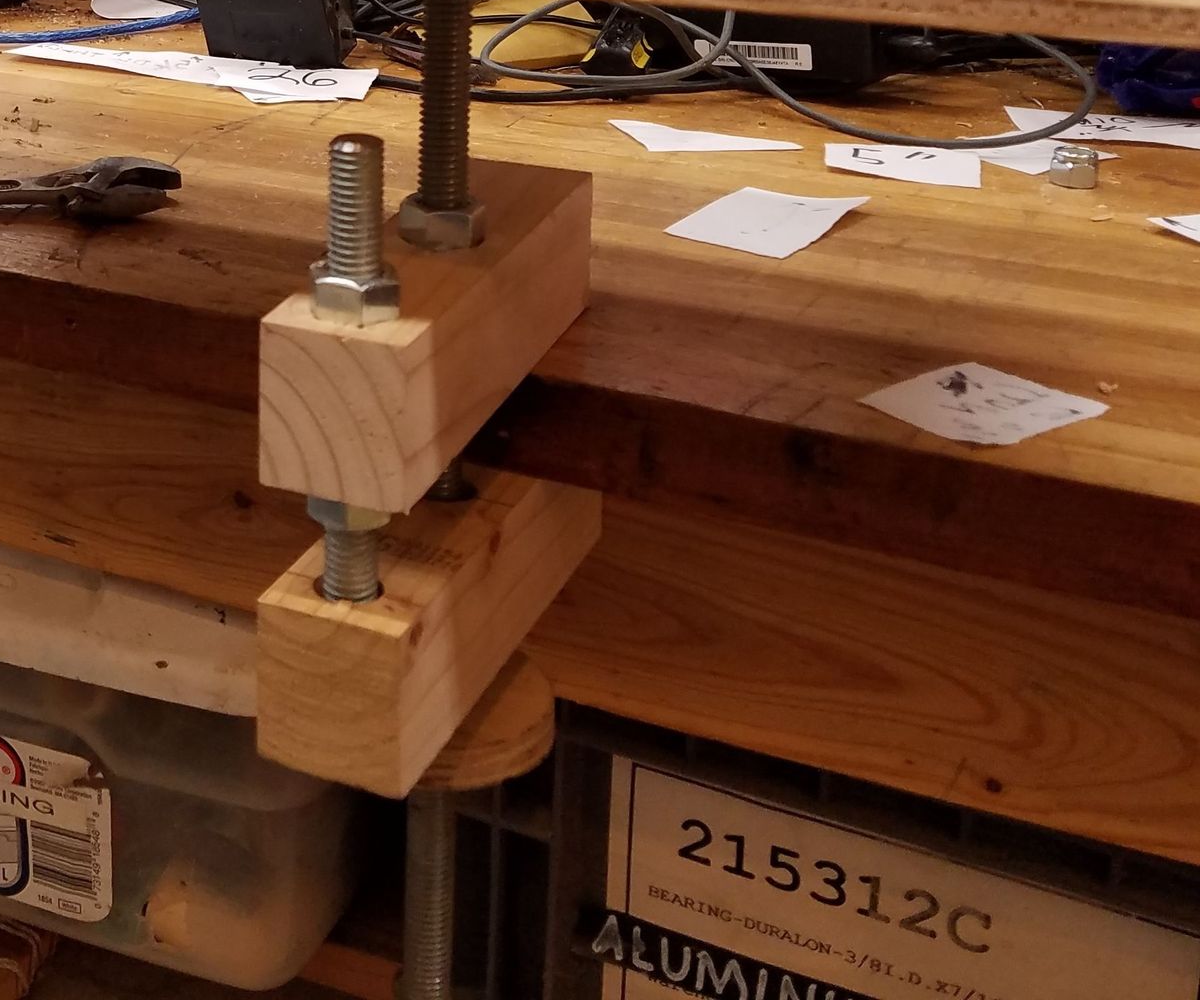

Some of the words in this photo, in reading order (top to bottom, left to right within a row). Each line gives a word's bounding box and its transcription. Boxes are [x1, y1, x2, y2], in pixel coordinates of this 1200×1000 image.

[247, 67, 338, 86] 26
[2, 867, 9, 881] L
[676, 818, 994, 955] 215312C
[61, 901, 78, 911] White
[591, 914, 840, 1000] ALUMIN
